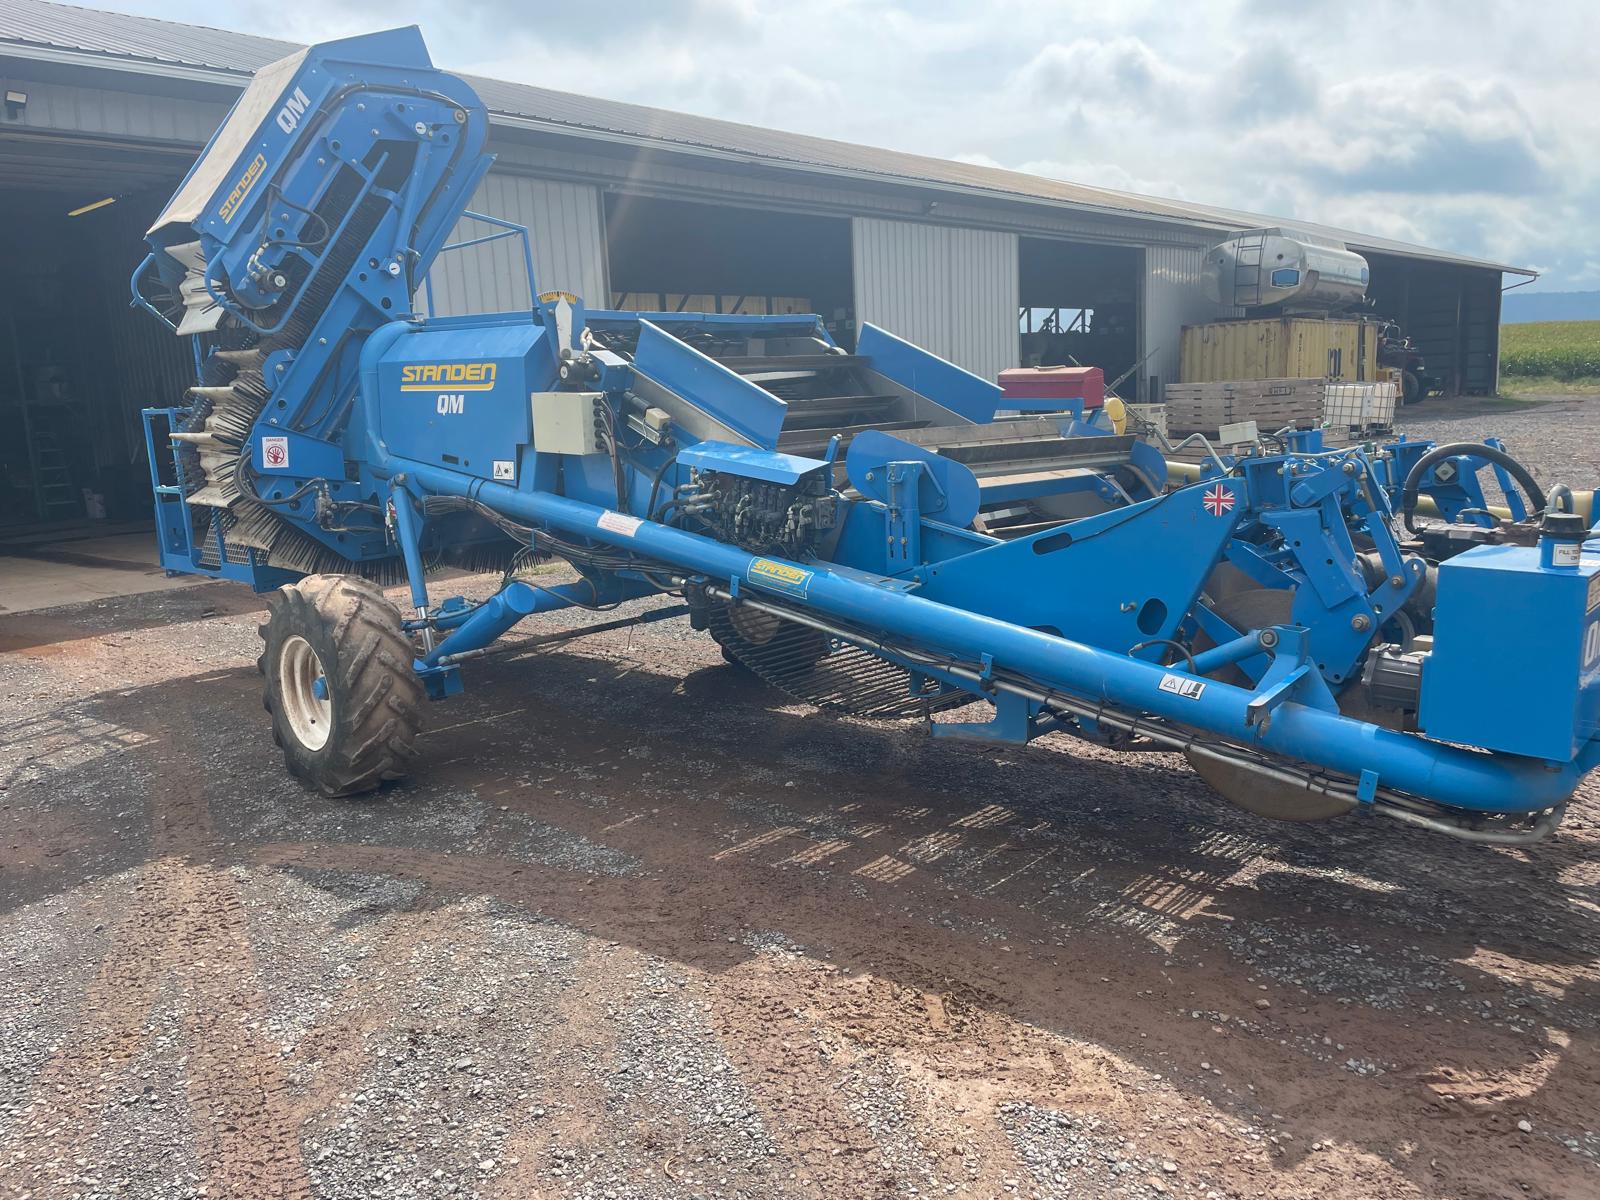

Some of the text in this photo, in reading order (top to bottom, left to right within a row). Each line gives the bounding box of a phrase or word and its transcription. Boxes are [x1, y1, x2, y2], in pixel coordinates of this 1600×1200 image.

[276, 86, 311, 134] QM
[219, 153, 265, 219] STANDEN
[402, 363, 497, 381] STANDEN
[437, 394, 464, 416] QM
[753, 560, 806, 582] STANDEN
